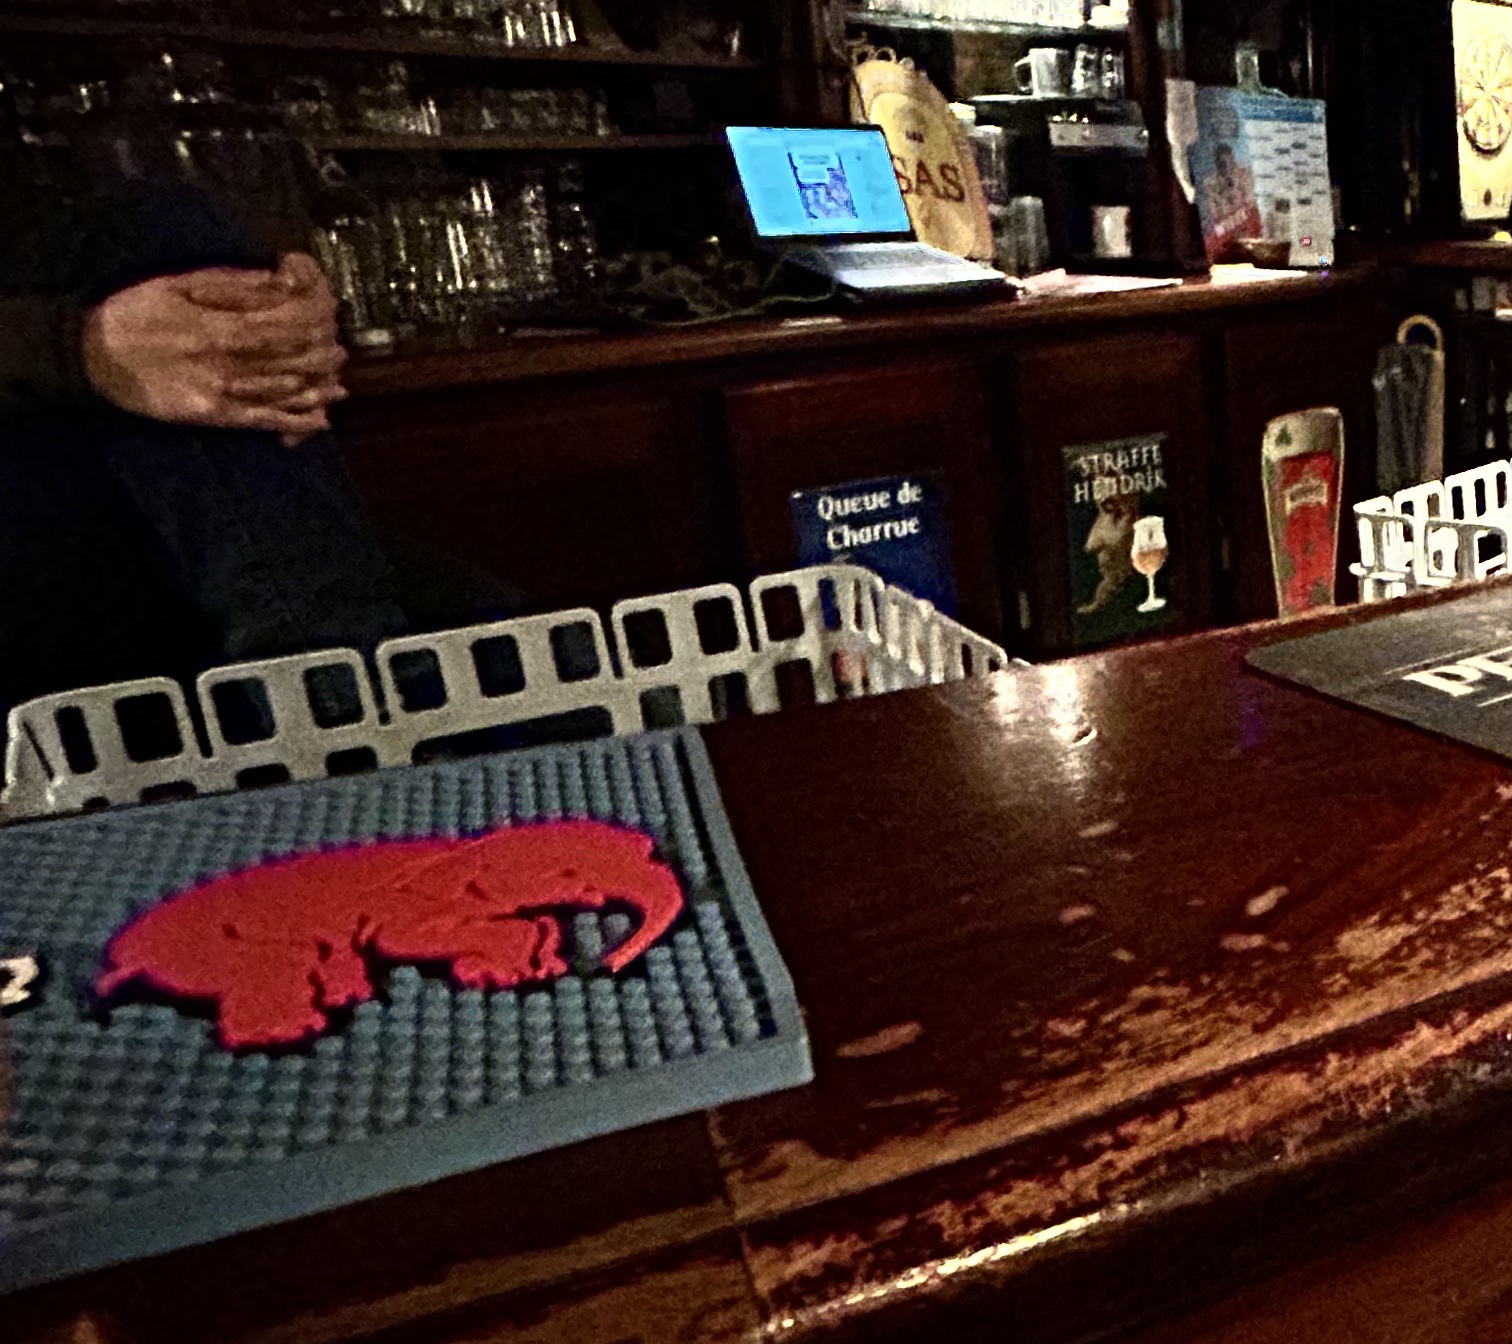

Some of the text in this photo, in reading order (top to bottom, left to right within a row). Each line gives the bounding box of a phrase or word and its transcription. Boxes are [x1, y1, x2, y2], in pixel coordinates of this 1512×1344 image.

[817, 481, 923, 521] Queue de
[826, 516, 921, 550] Charrue
